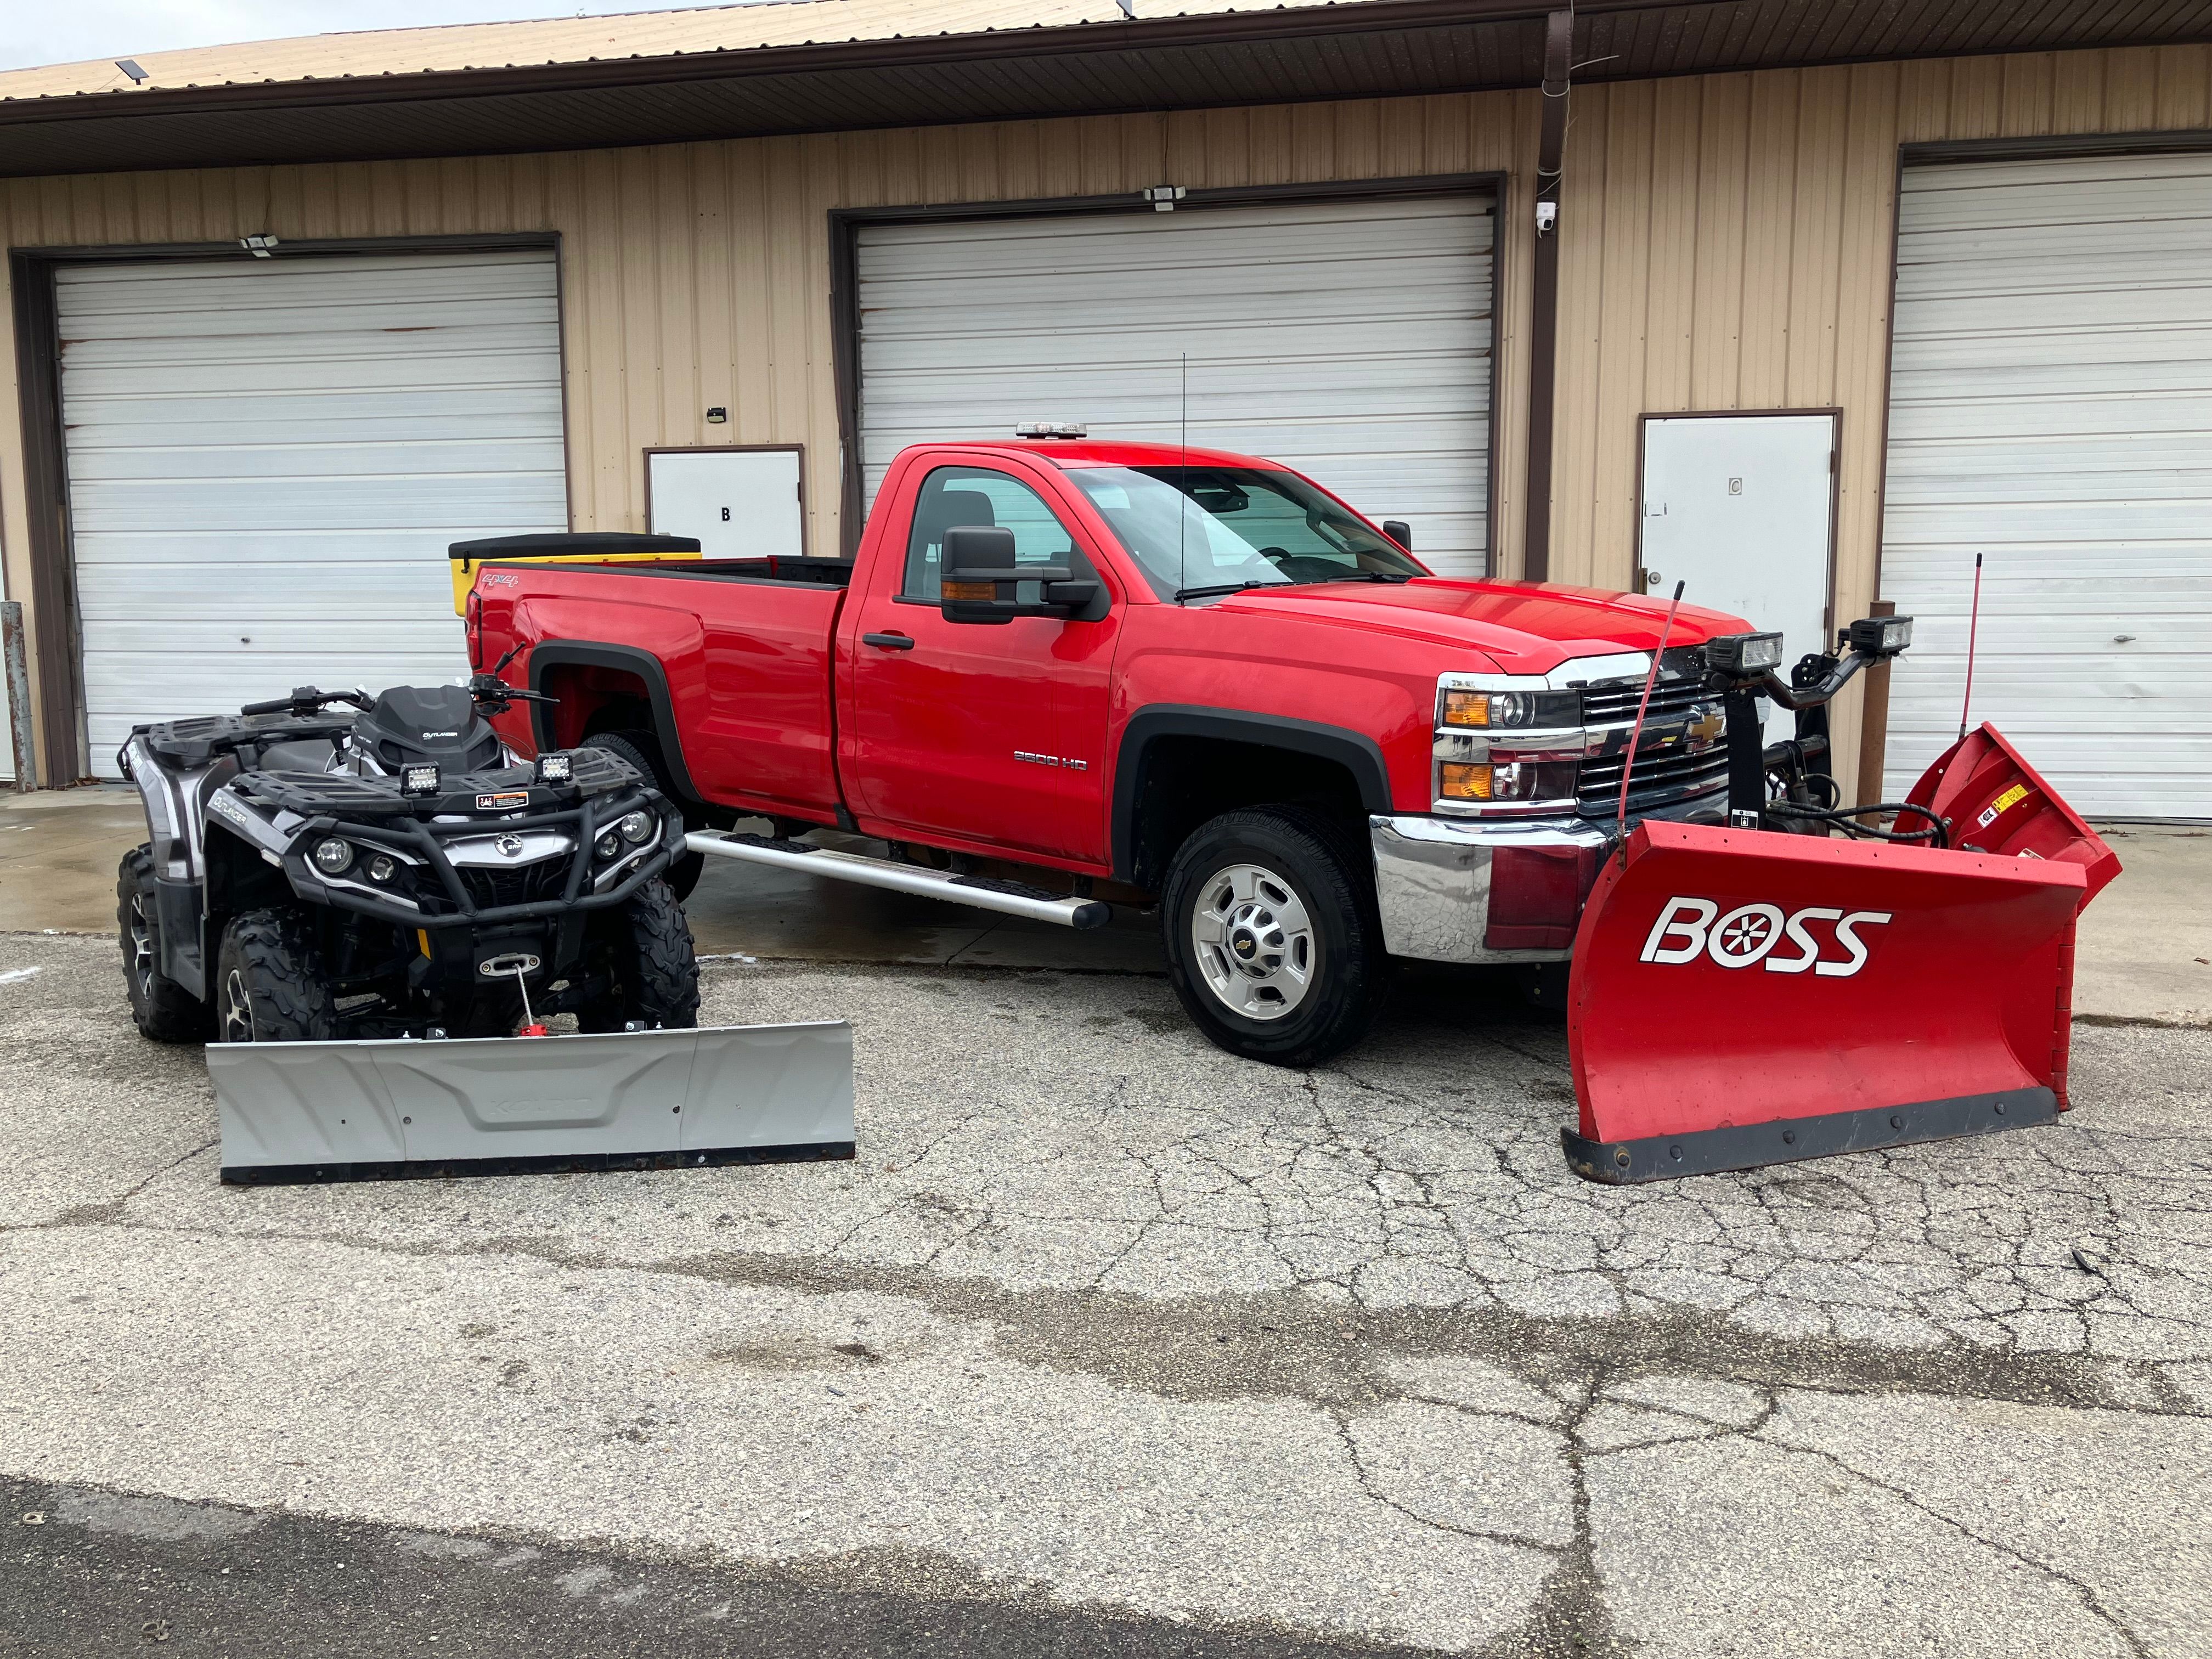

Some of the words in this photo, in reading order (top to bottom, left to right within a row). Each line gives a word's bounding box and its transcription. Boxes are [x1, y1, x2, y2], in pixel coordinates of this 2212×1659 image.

[721, 507, 730, 521] B
[1014, 751, 1059, 766] 2500
[1062, 758, 1087, 770] HD
[213, 796, 246, 825] OUTLANDER
[1639, 895, 1893, 977] BOSS
